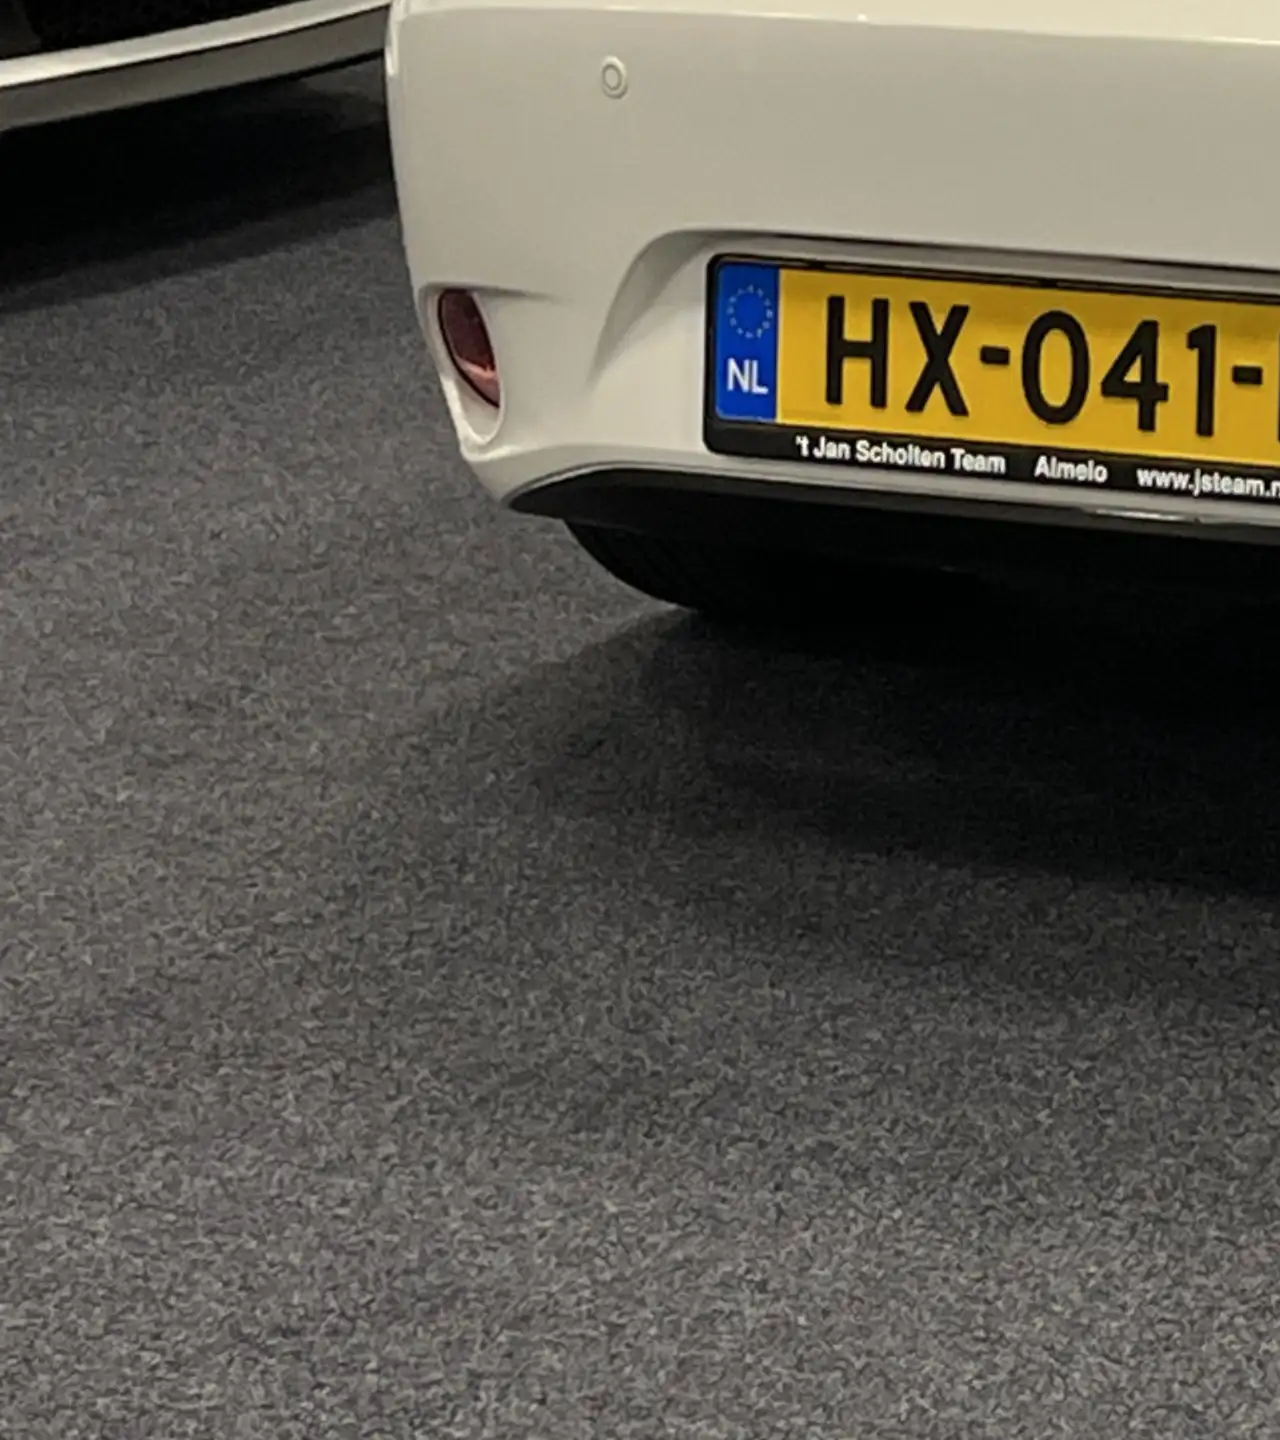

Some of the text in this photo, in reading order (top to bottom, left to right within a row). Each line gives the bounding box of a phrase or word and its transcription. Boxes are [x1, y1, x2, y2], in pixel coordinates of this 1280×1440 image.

[726, 358, 769, 394] NL
[812, 436, 851, 461] Jan
[855, 439, 946, 469] Scholten
[949, 447, 1006, 474] Team
[1033, 455, 1109, 484] Almelo
